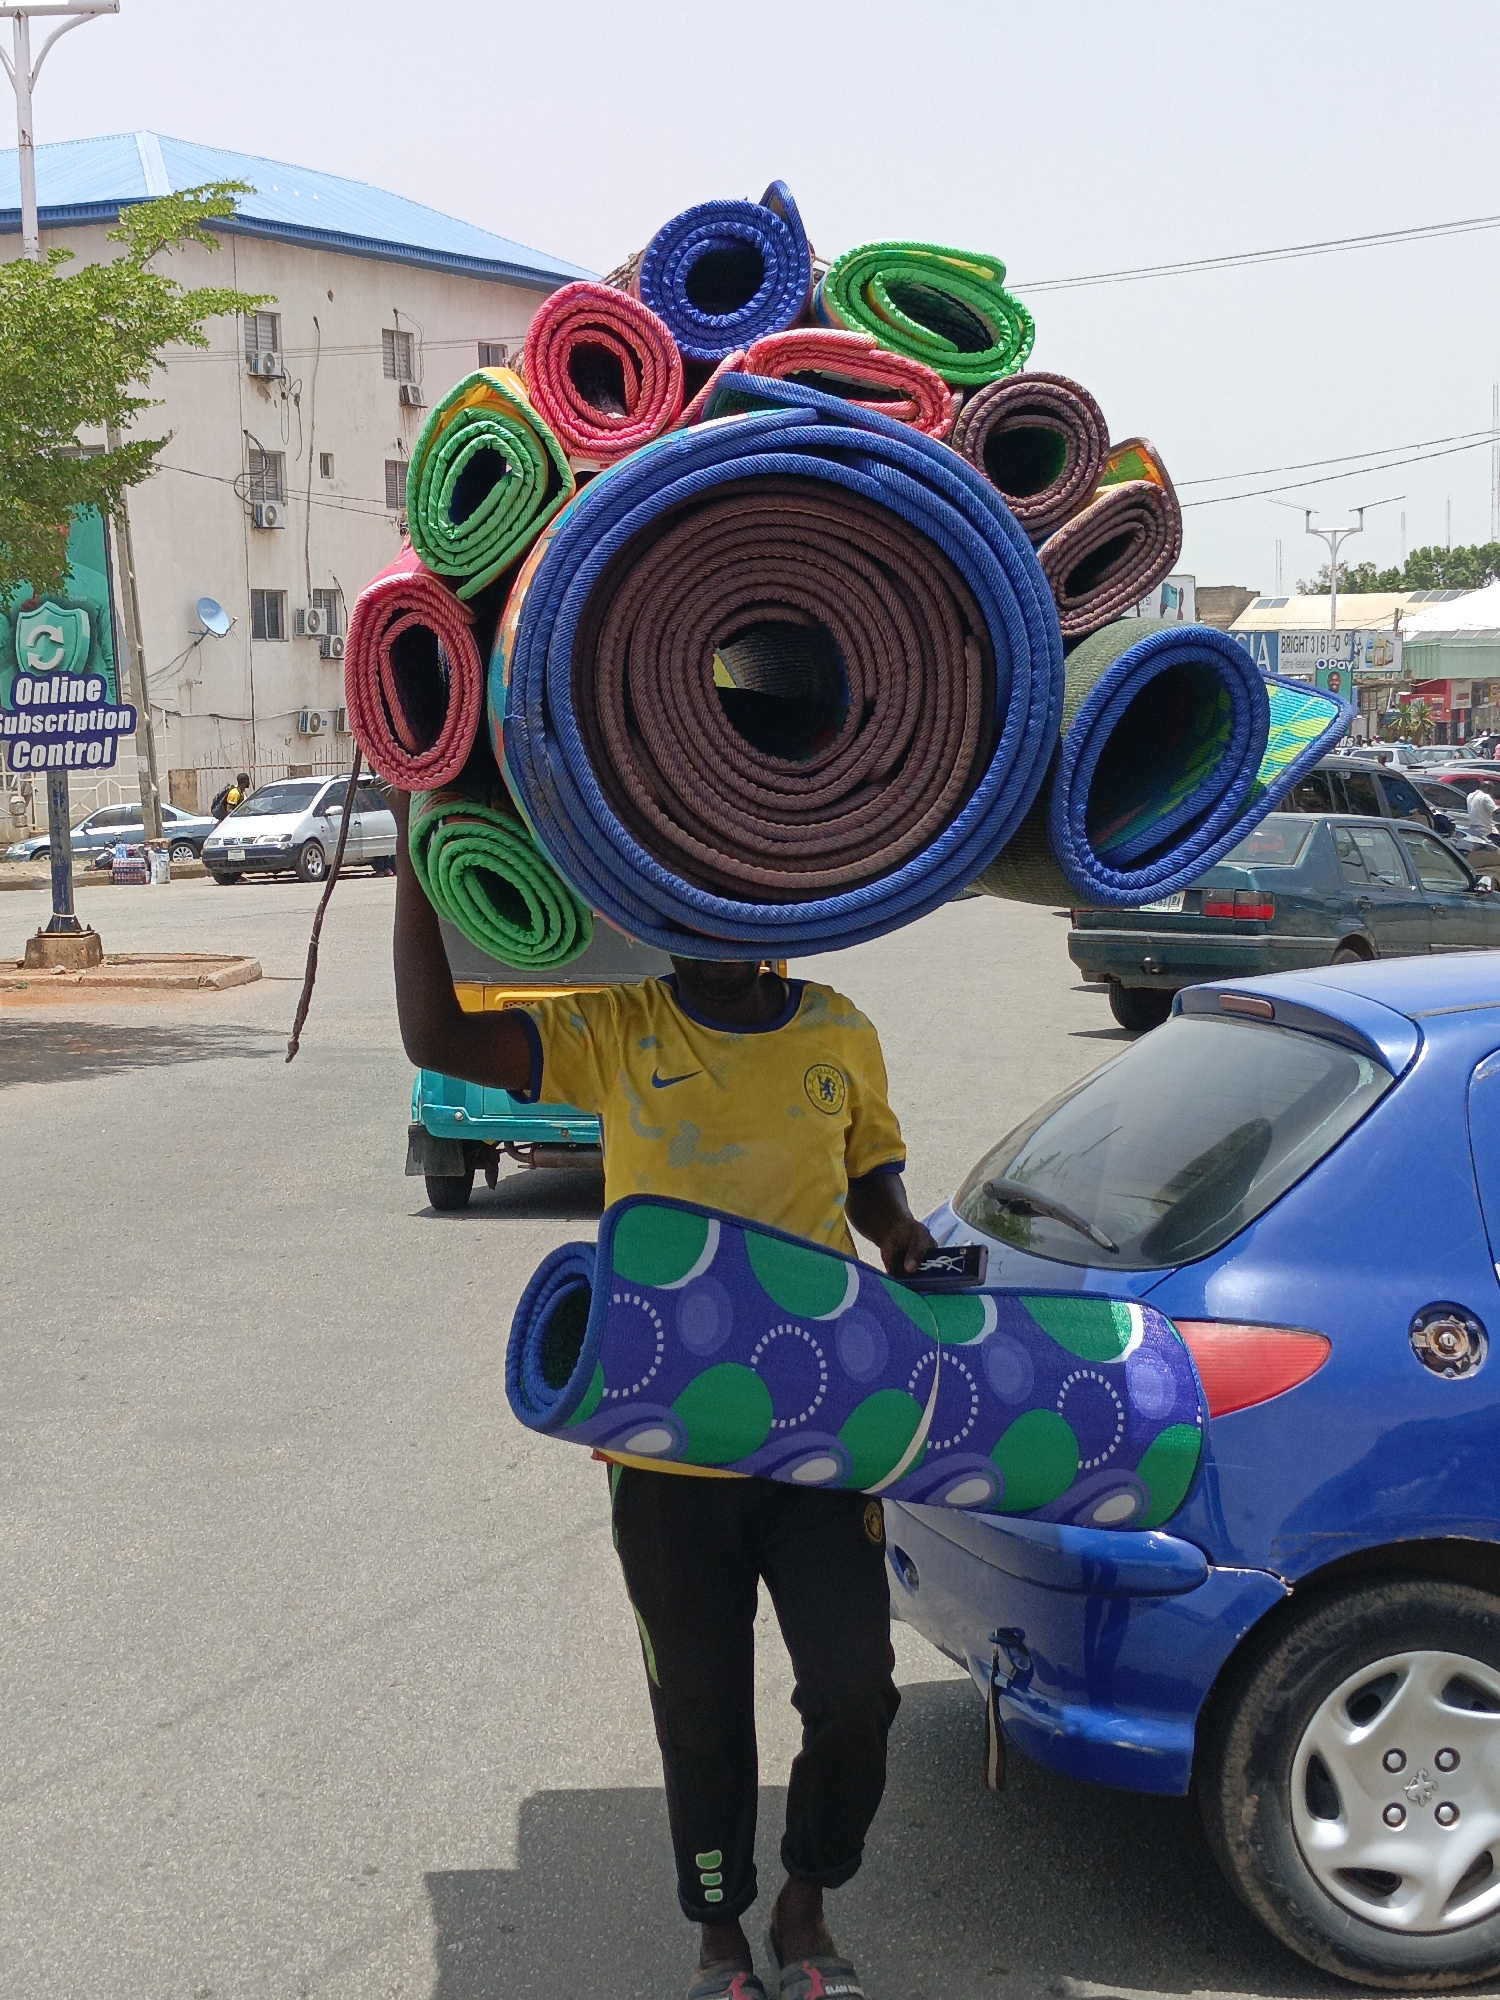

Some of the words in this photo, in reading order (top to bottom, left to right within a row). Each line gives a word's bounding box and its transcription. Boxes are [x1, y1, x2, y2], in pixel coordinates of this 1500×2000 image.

[1281, 635, 1309, 654] BRIGHT
[1316, 658, 1353, 672] OPay
[16, 676, 101, 706] Online
[0, 709, 130, 734] Subscription
[12, 736, 113, 769] Control
